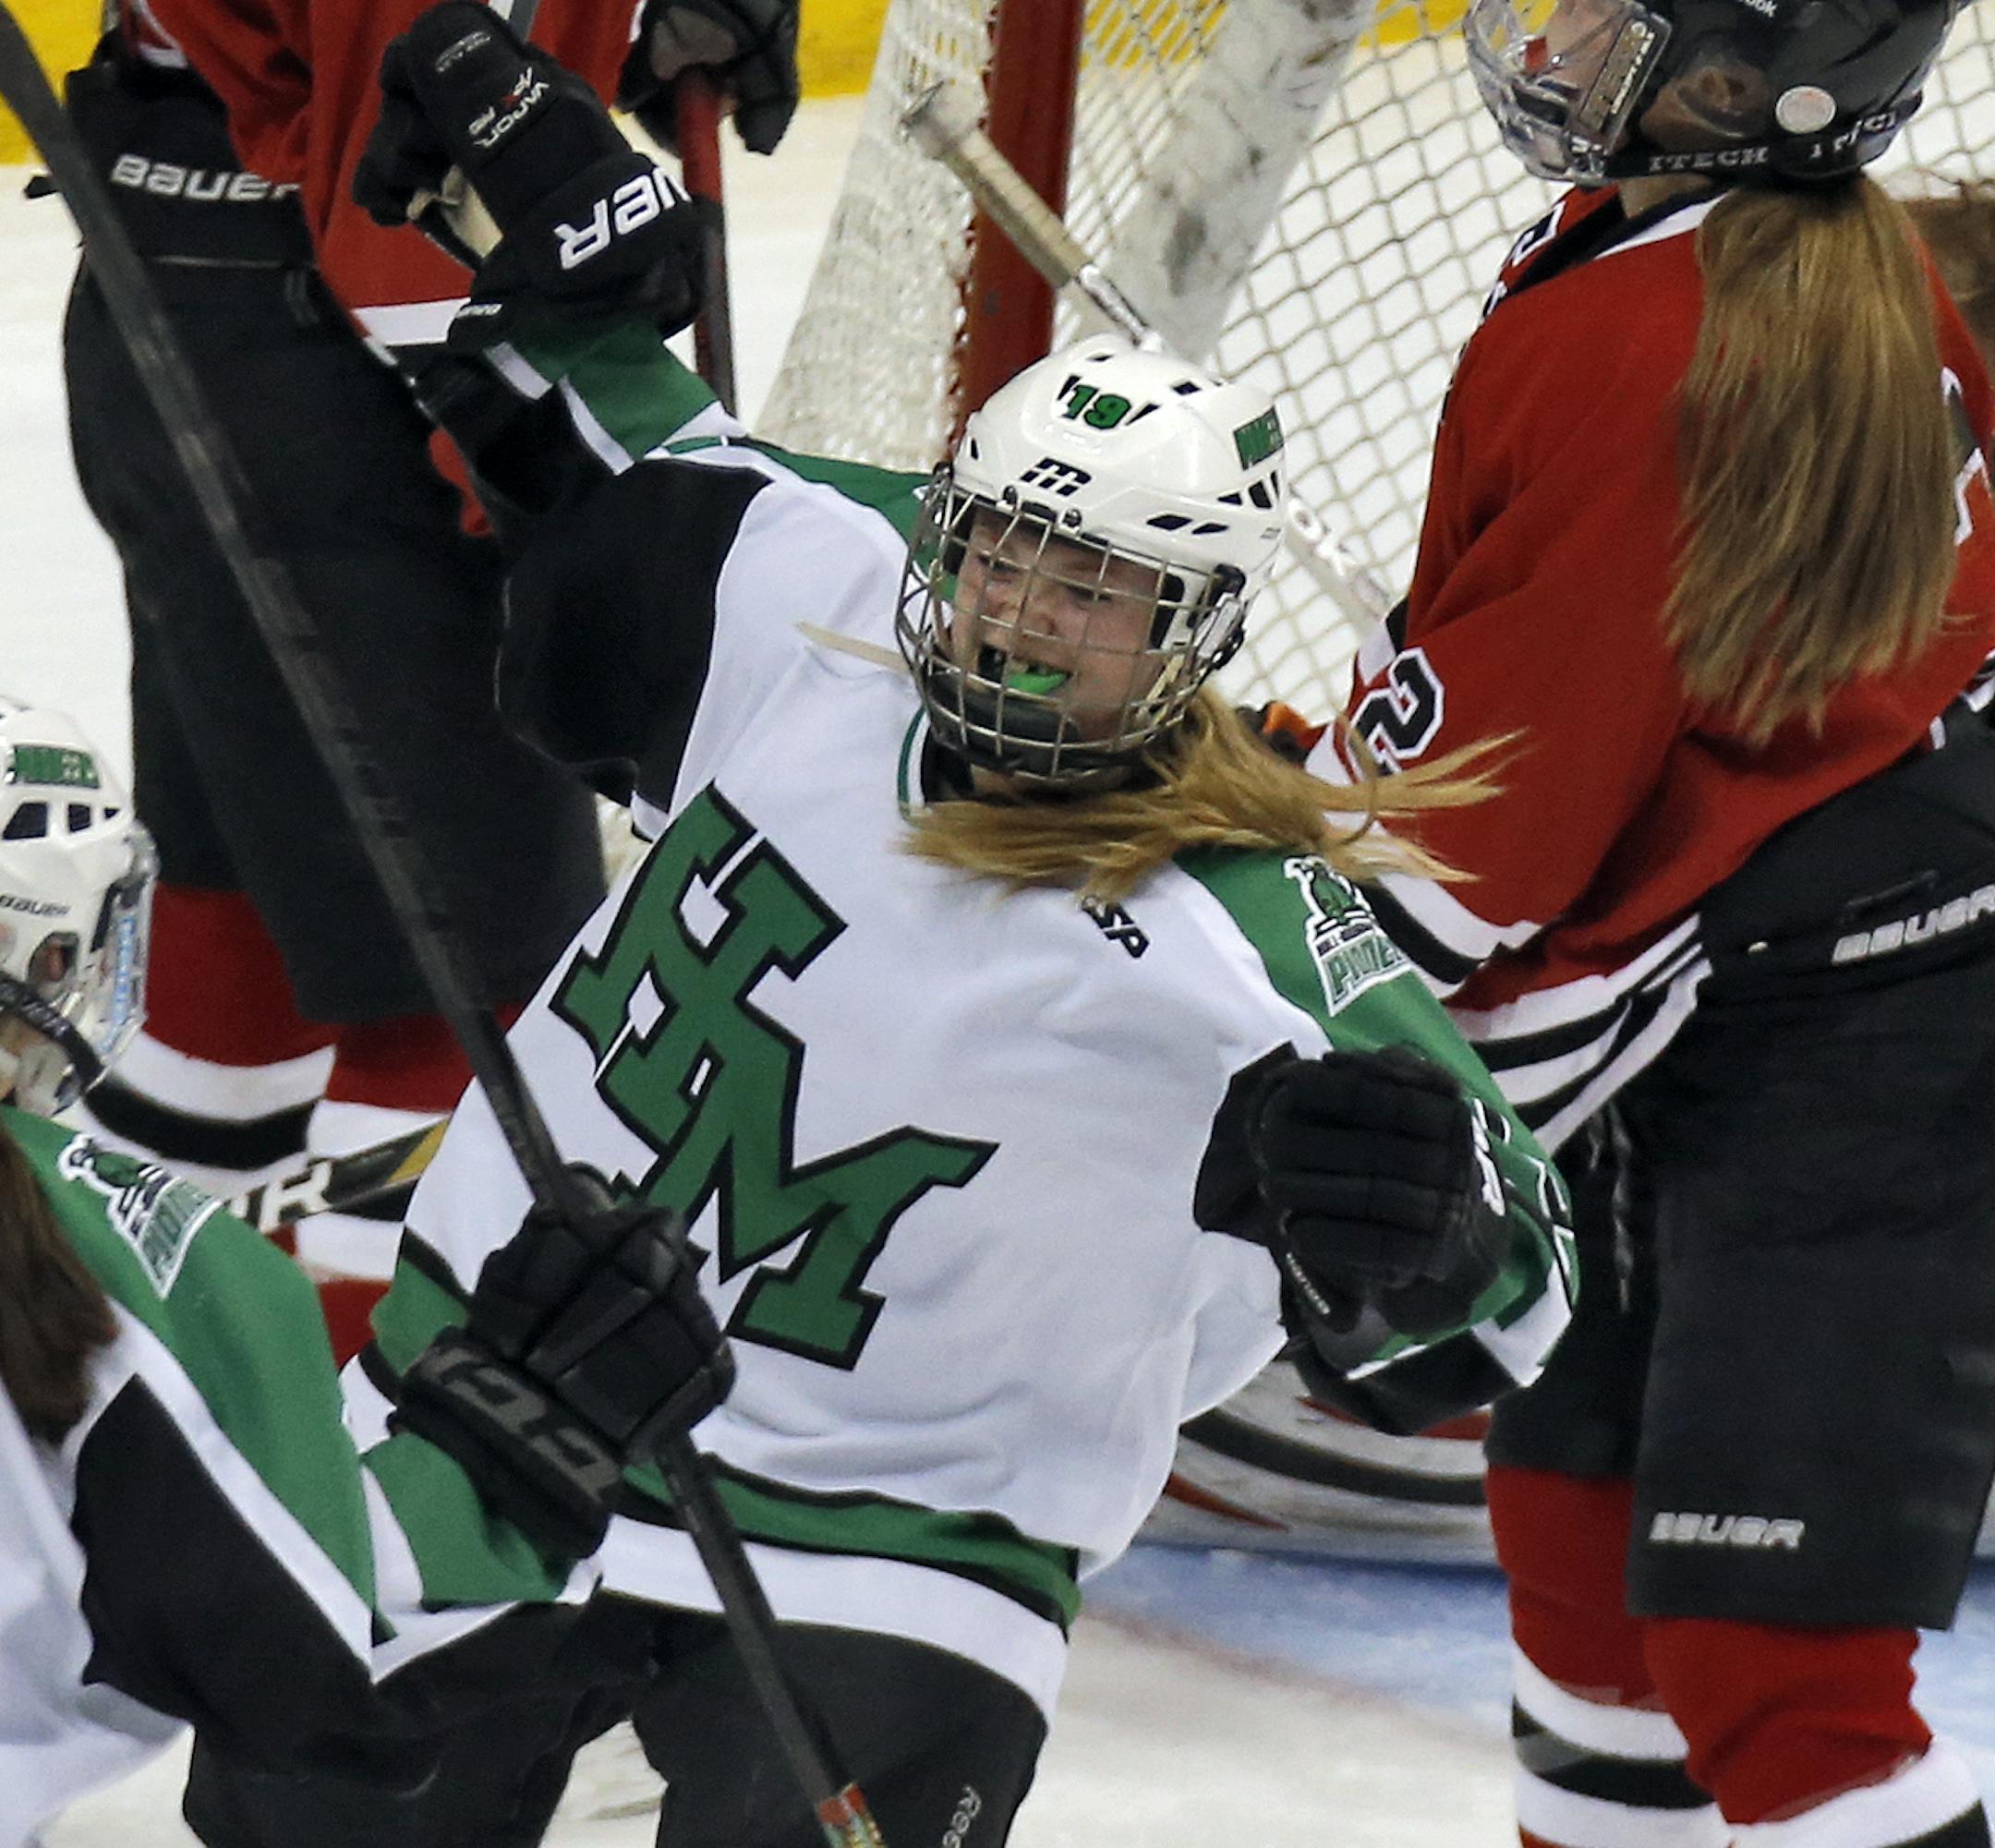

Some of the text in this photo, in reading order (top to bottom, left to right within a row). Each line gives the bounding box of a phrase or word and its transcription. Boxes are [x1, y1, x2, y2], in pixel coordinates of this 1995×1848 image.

[472, 81, 550, 148] VAPOR
[1060, 384, 1131, 430] 19
[1345, 646, 1445, 780] 2
[1648, 1512, 1805, 1551] BAUER
